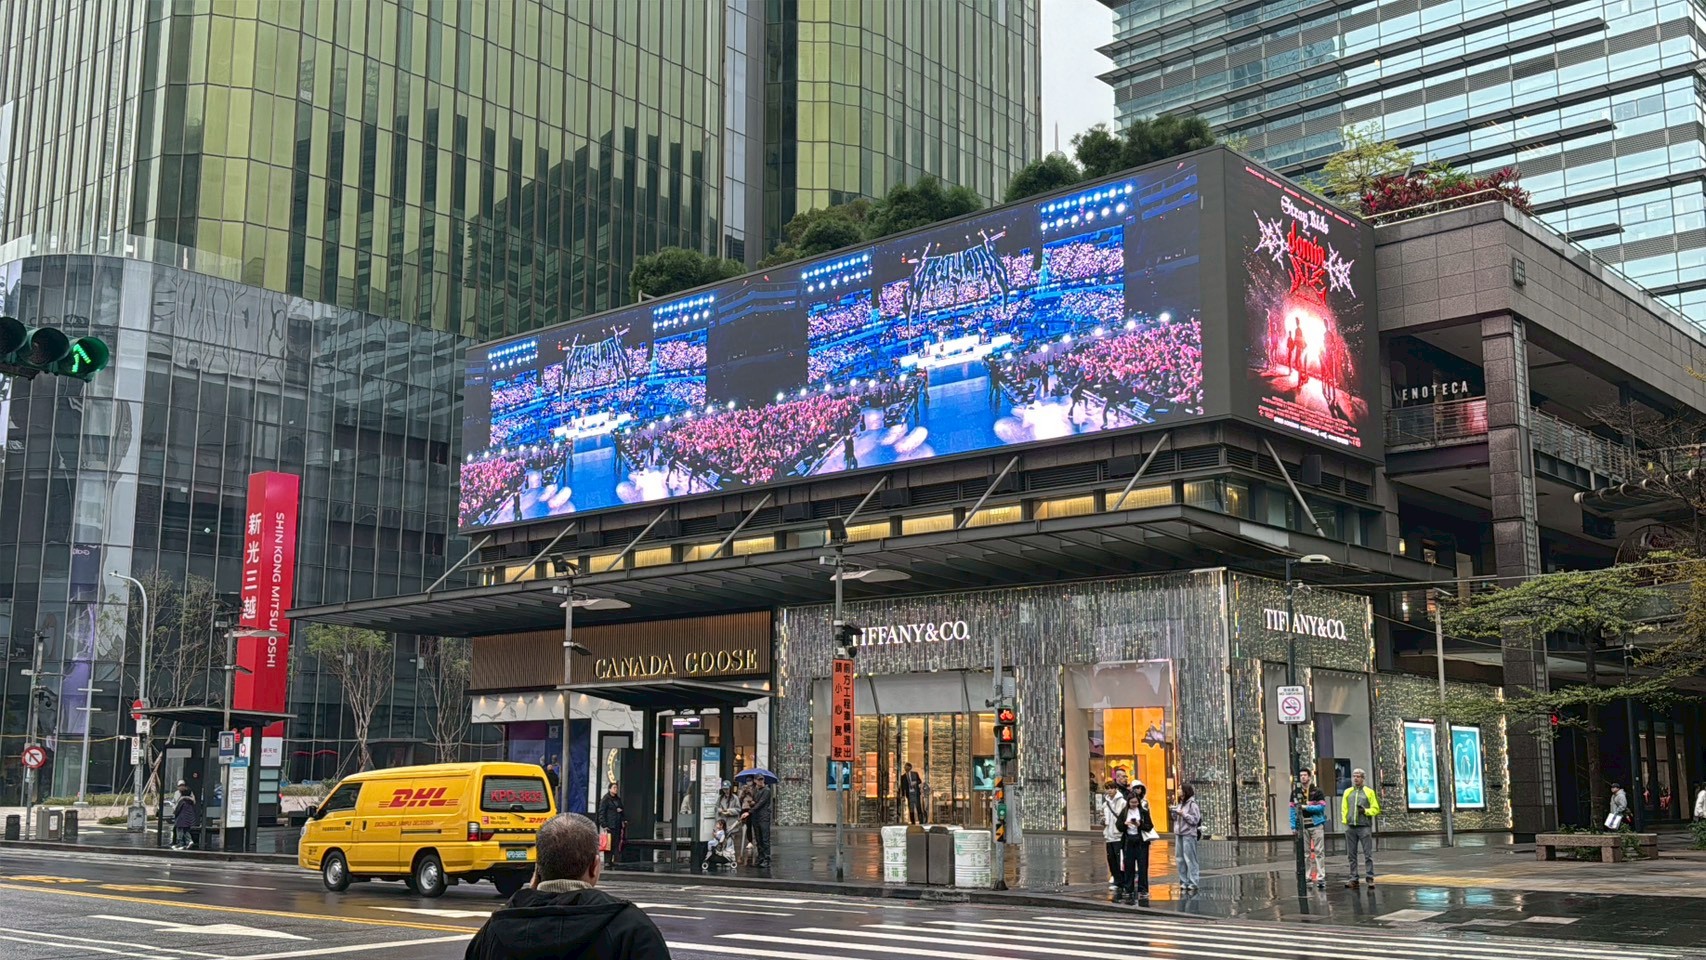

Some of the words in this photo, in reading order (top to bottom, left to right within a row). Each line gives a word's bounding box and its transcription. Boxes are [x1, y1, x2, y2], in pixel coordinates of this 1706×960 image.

[1402, 380, 1468, 401] ENOTECA
[274, 512, 285, 545] SHIN
[242, 512, 262, 619] 新光三越
[272, 546, 283, 583] KONG
[266, 588, 280, 668] MITSUOSHI
[595, 653, 677, 679] CANADA
[685, 649, 757, 674] GOOSE
[388, 787, 448, 808] DHL
